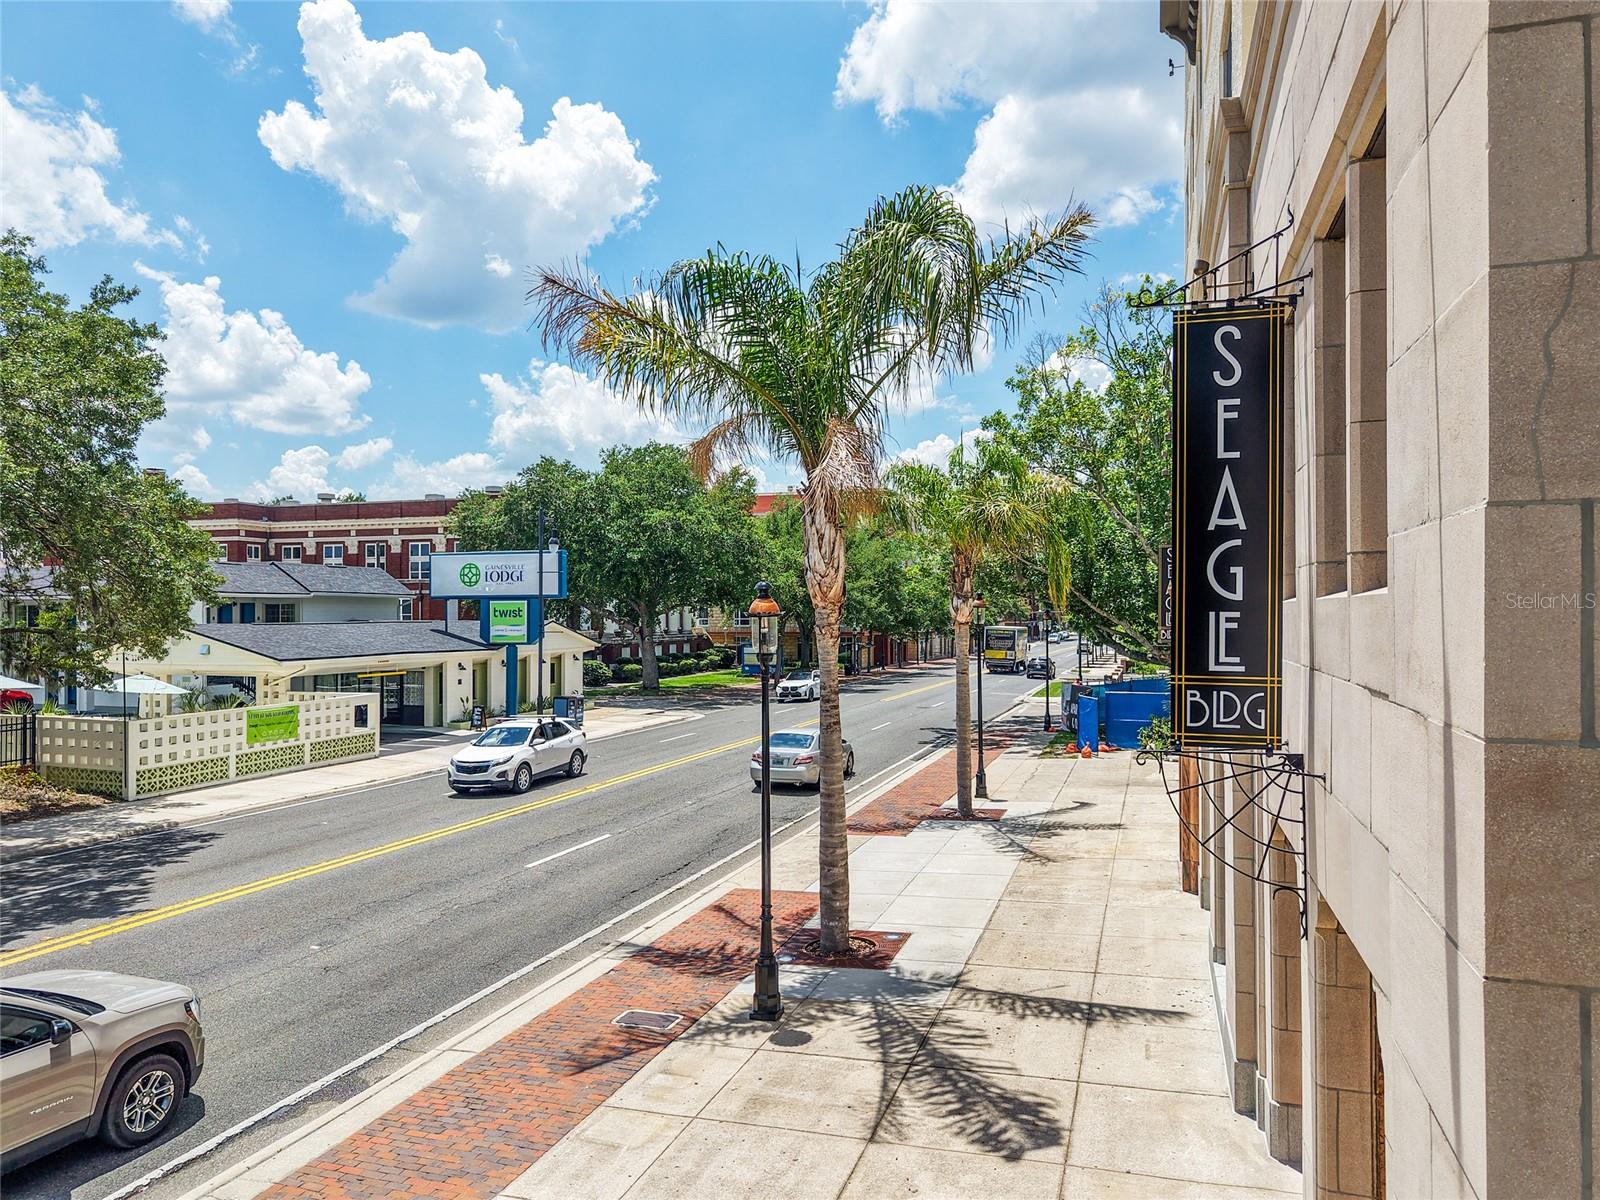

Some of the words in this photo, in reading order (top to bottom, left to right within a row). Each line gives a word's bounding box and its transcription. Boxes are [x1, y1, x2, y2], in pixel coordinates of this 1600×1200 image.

[1206, 324, 1247, 672] SEAGLE
[485, 570, 524, 583] LODGE
[493, 607, 523, 618] twist
[1186, 689, 1266, 730] BLDG
[30, 1095, 74, 1115] TERRAIN
